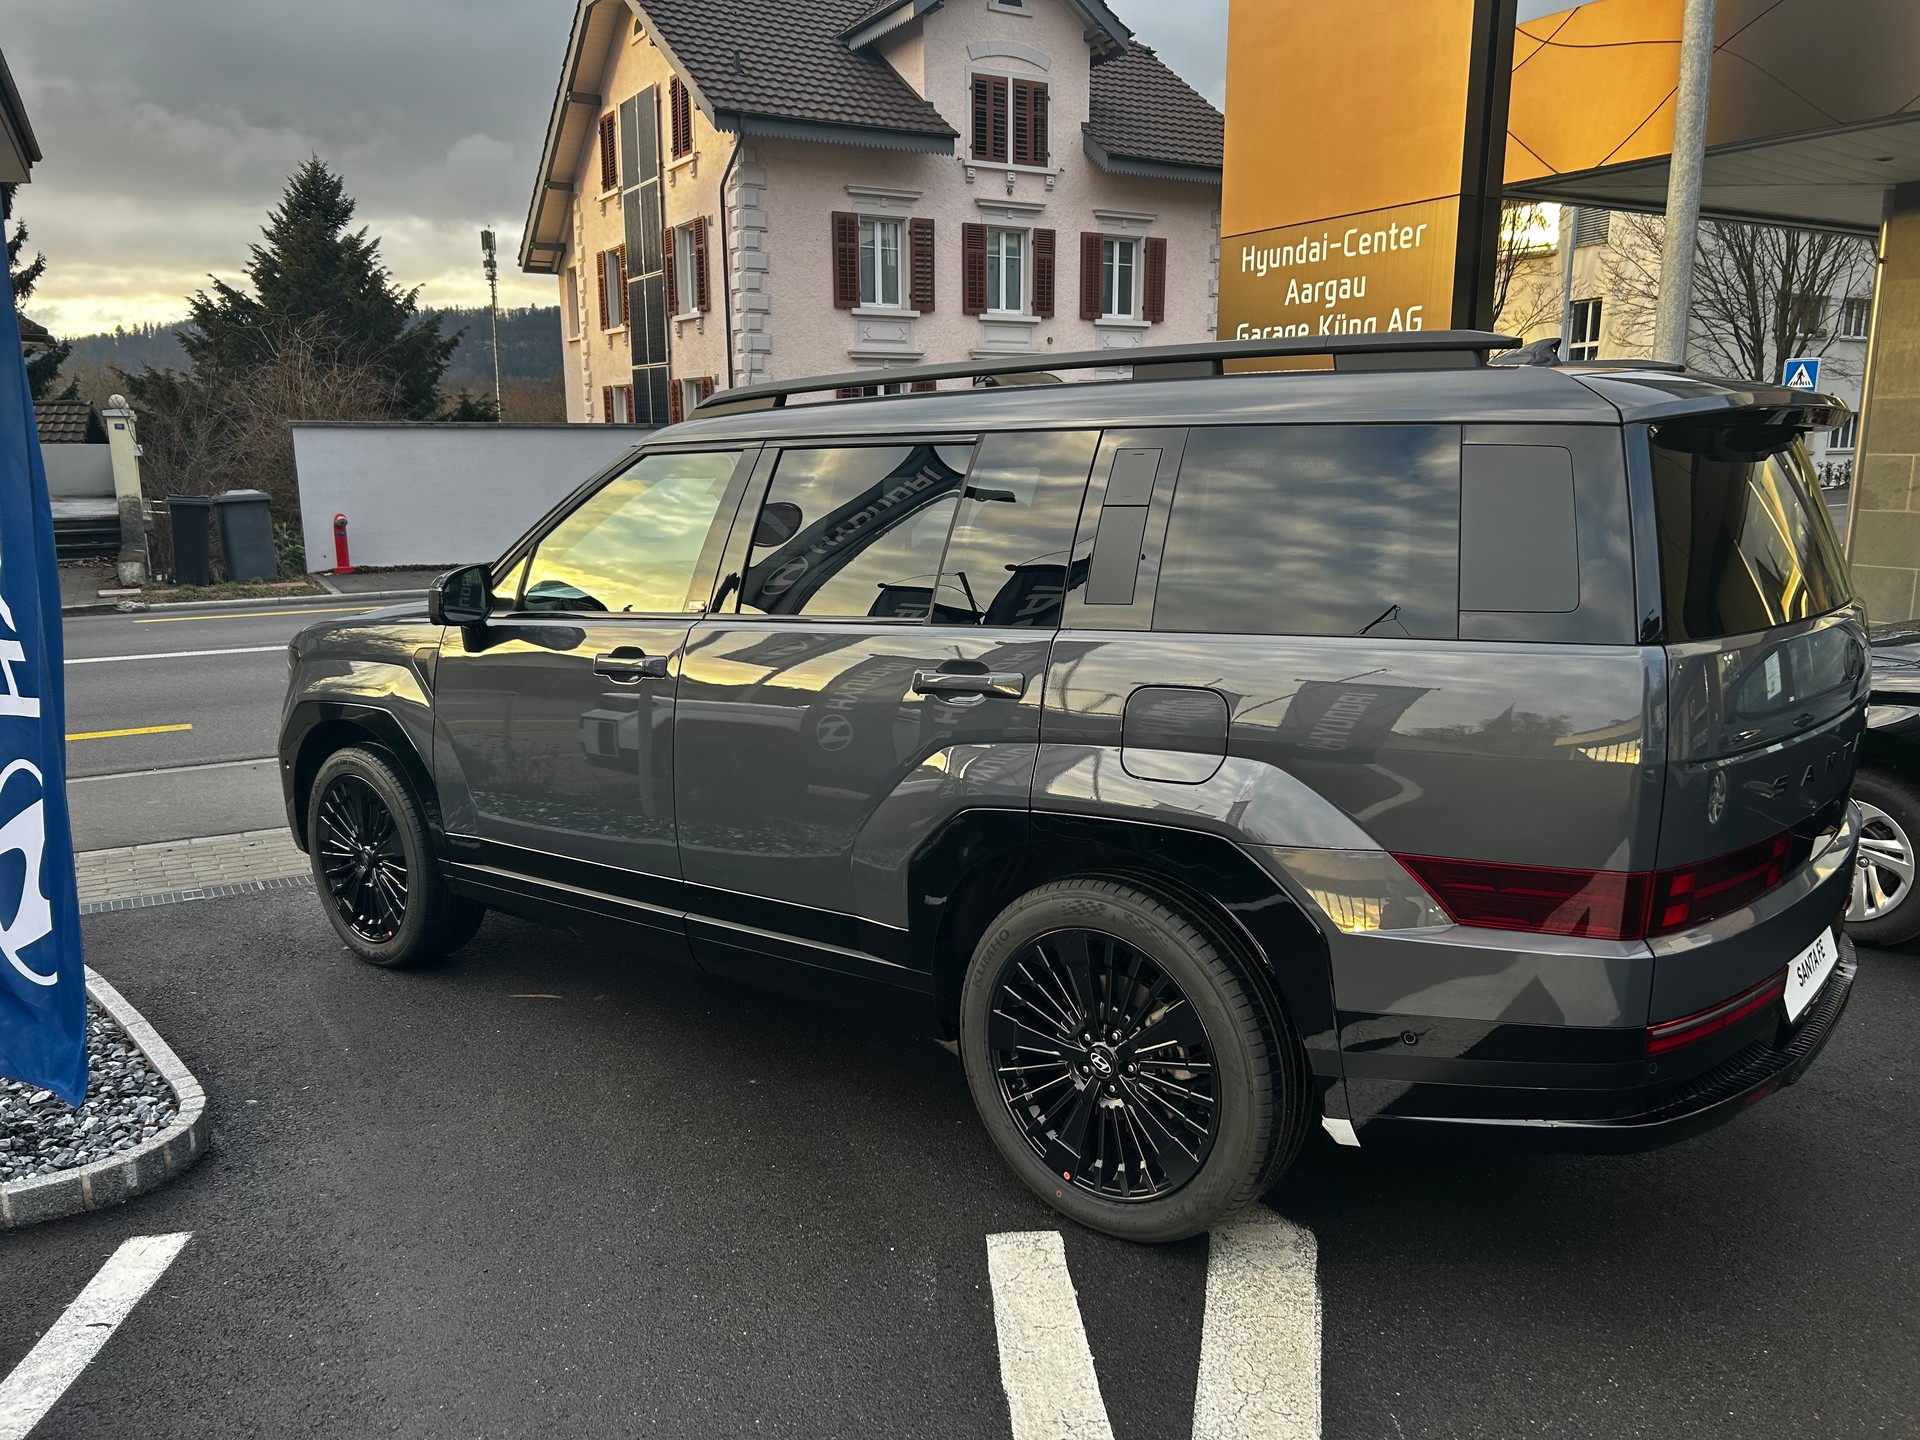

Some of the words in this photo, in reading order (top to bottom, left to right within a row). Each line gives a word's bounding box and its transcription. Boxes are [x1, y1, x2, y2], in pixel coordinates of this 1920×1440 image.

[1241, 222, 1428, 277] Hyundai-Center
[1284, 275, 1367, 308] Aargau
[1387, 305, 1423, 333] AG
[971, 928, 1010, 988] KUMHO
[1796, 948, 1820, 987] SANTA
[1815, 937, 1826, 963] FE
